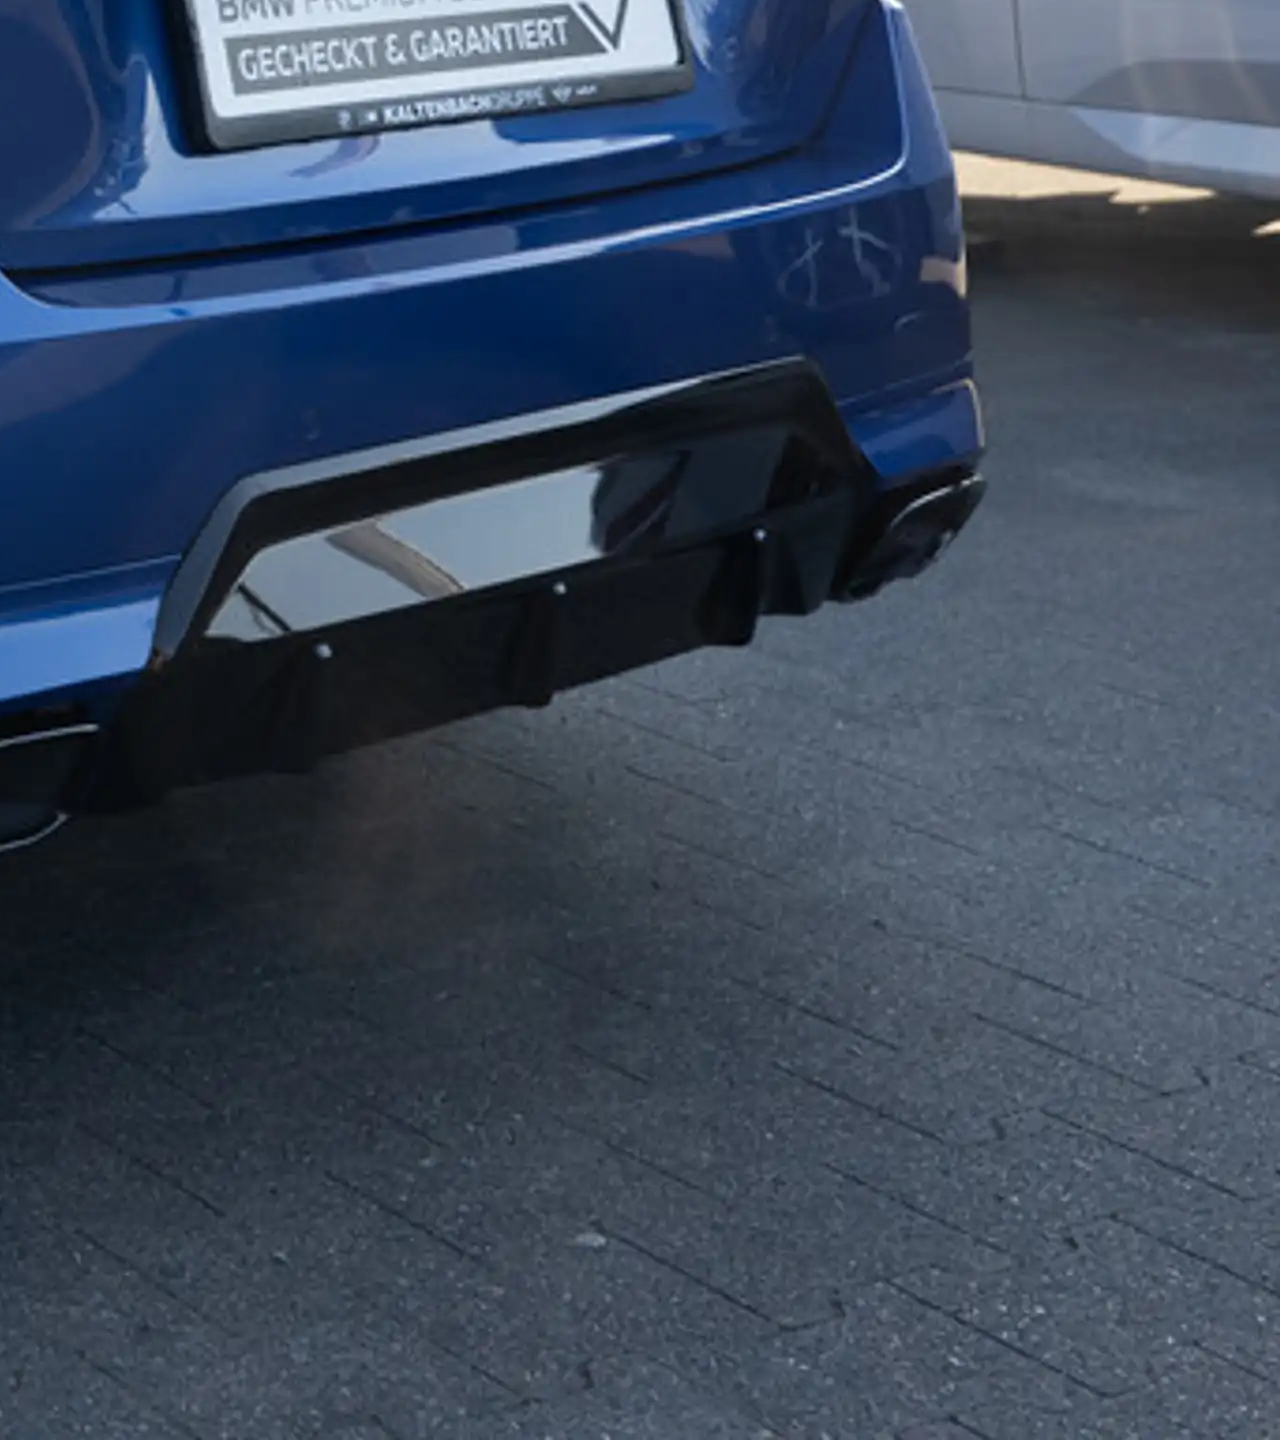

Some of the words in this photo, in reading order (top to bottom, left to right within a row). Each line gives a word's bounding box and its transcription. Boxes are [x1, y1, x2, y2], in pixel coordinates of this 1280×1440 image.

[238, 35, 378, 81] GECHECKT
[384, 33, 407, 65] &
[409, 14, 569, 63] GARANTIERT
